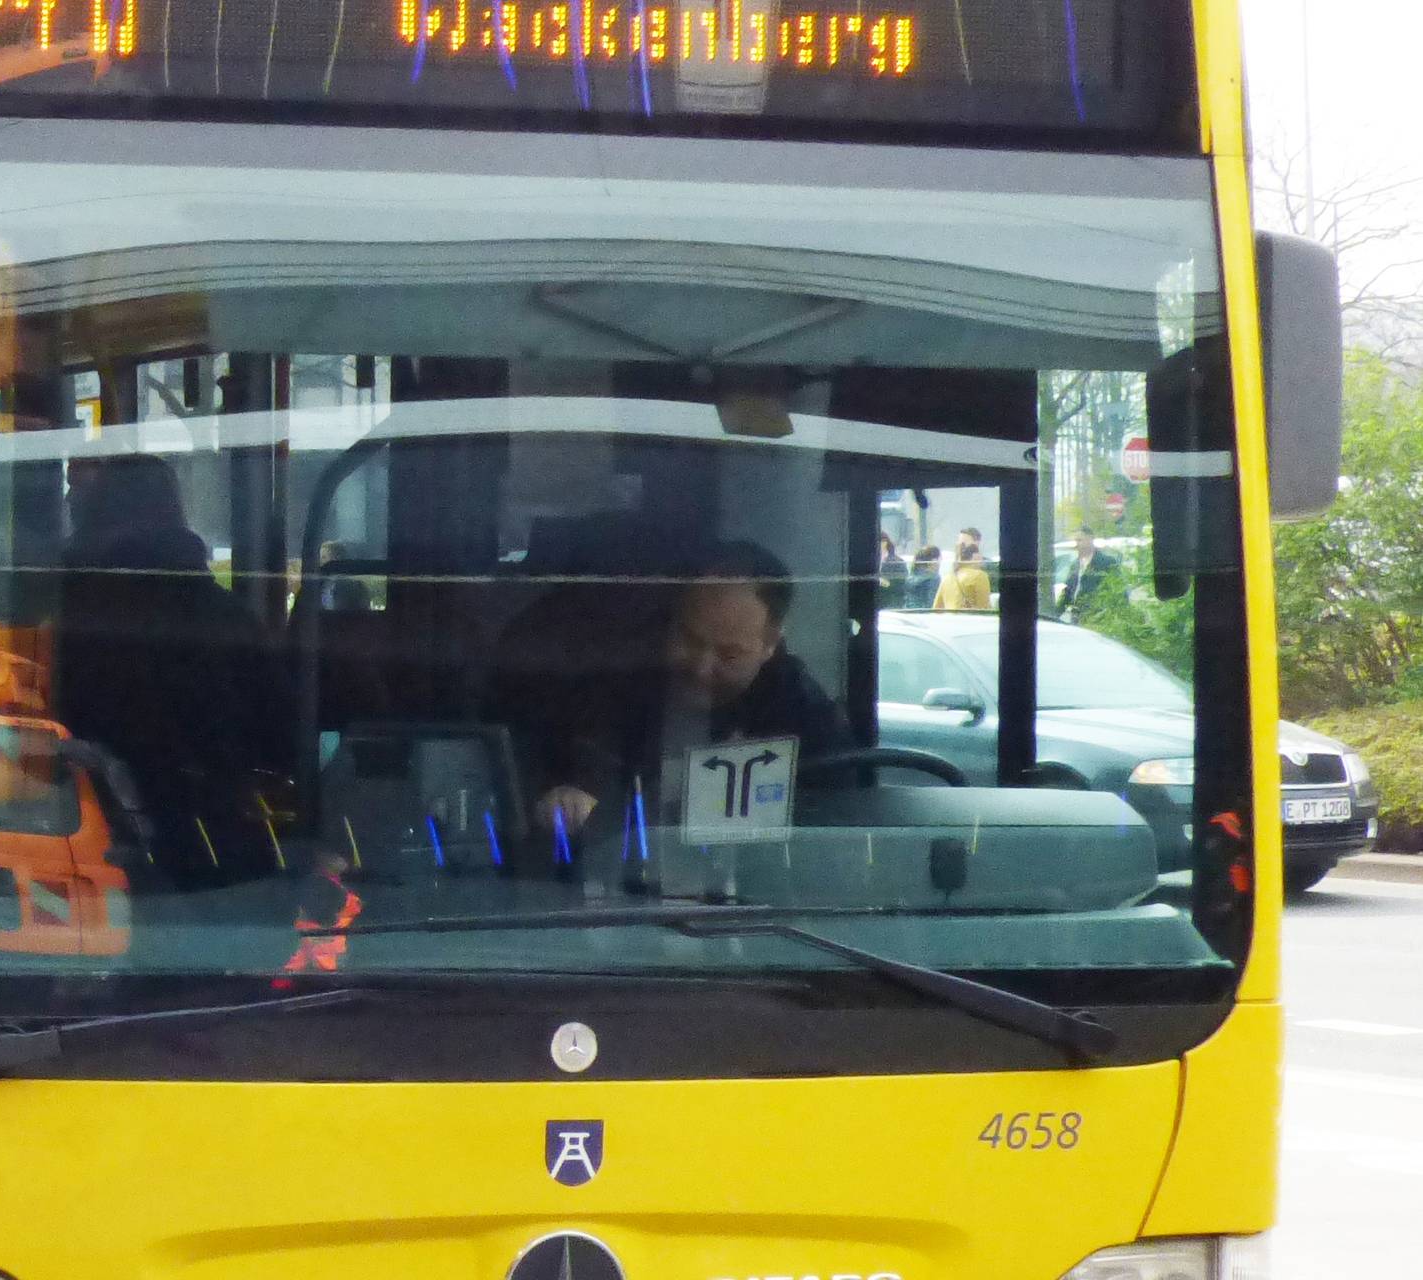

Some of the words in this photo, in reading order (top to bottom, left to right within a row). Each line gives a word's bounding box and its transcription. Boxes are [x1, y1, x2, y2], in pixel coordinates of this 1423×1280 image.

[1286, 803, 1294, 818] E
[1303, 802, 1318, 818] PT
[978, 1111, 1082, 1149] 4658
